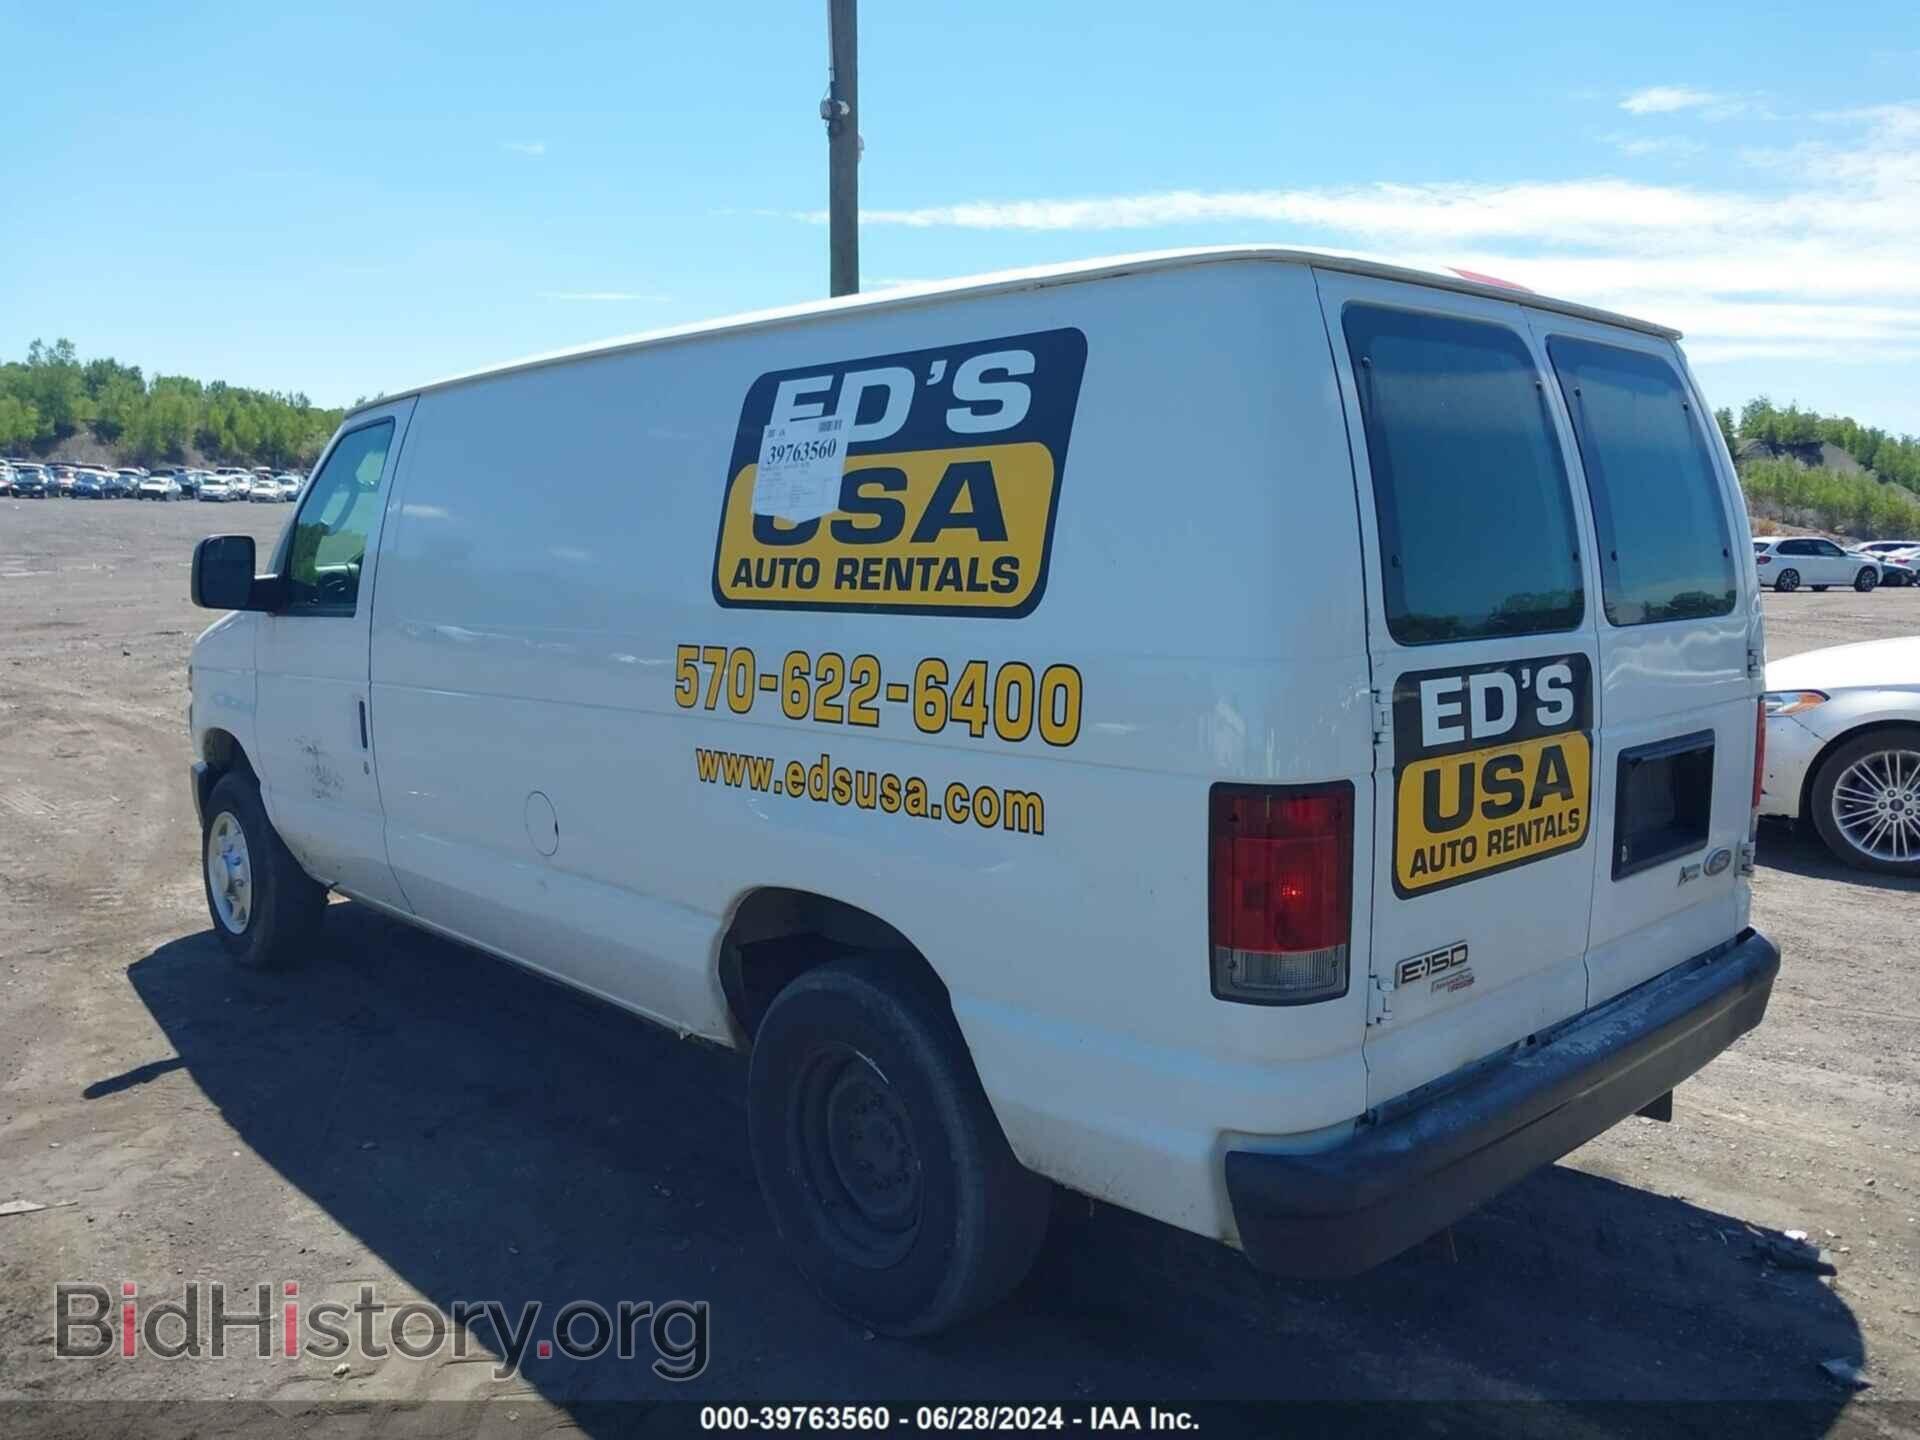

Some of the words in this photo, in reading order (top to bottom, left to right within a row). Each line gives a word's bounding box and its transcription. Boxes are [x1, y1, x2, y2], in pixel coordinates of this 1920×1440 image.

[767, 439, 837, 465] 39763560
[731, 557, 820, 589] AUTO
[834, 556, 1019, 593] RENTALS
[674, 645, 1082, 746] 570-622-6400
[1420, 664, 1574, 747] ED'S
[696, 748, 1045, 836] www.edsusa.com
[1423, 745, 1574, 834] USA
[1409, 836, 1477, 878] AUTO
[1487, 808, 1580, 857] RENTALS
[1401, 944, 1468, 985] E-150
